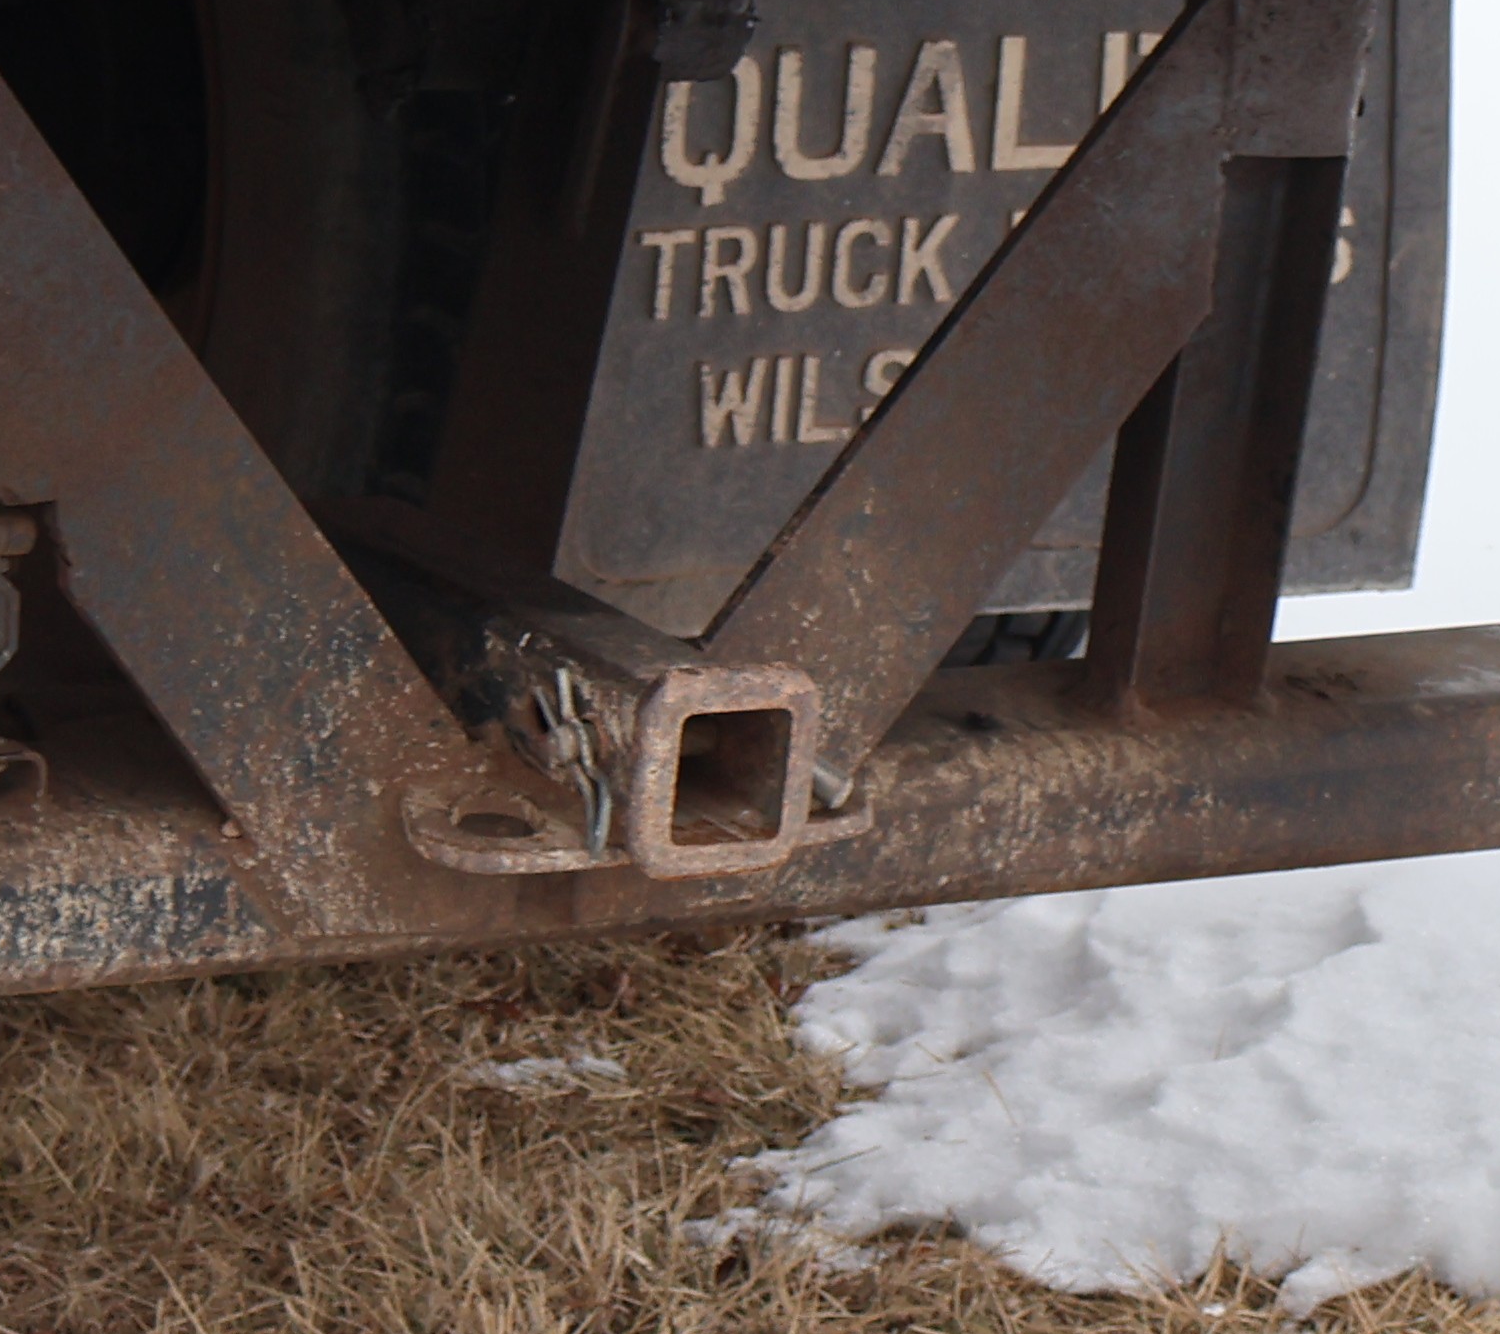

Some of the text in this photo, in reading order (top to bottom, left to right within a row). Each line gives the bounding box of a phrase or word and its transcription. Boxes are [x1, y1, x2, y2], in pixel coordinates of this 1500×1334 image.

[659, 29, 1164, 208] QUALI
[641, 212, 960, 321] TRUCK
[700, 348, 918, 449] WILS
